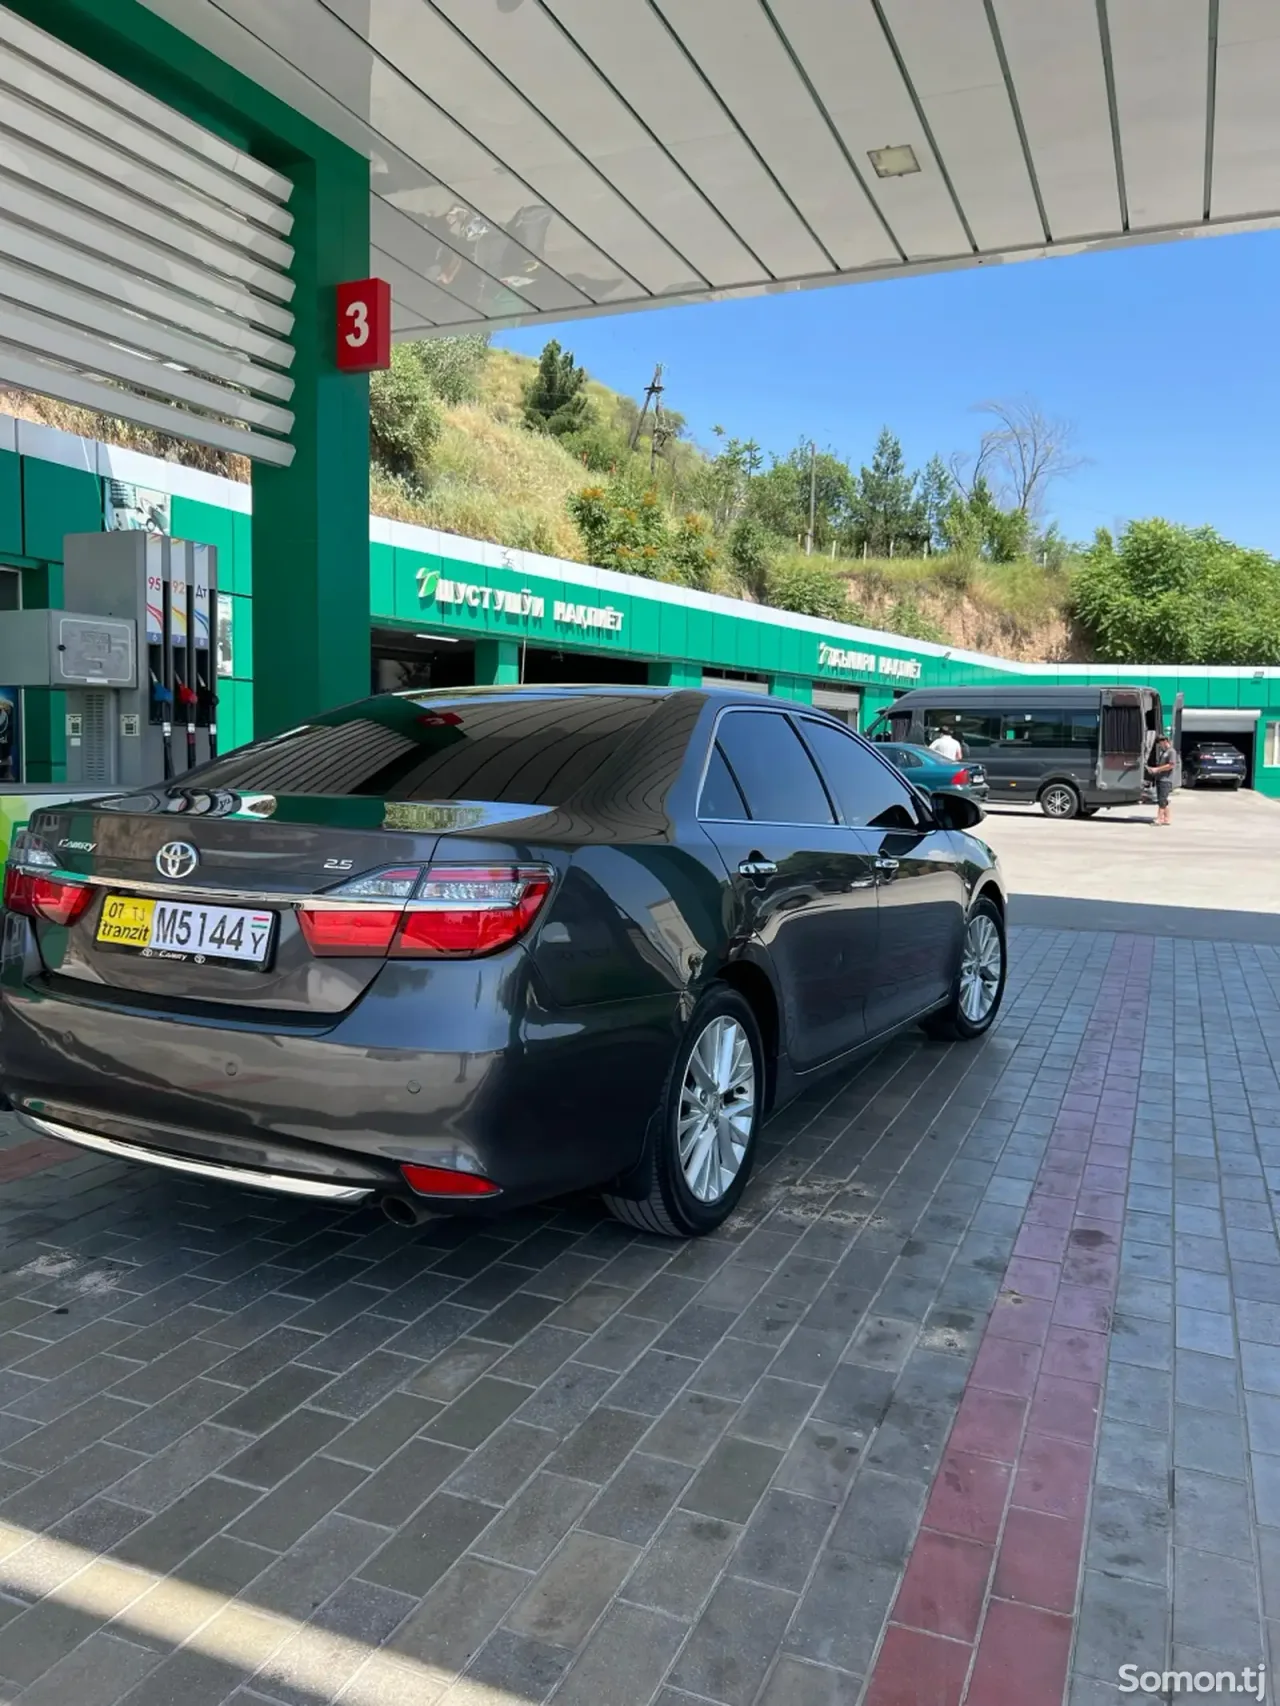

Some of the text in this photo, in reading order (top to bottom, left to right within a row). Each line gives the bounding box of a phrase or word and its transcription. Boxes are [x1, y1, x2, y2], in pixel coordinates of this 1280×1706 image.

[345, 300, 369, 348] 3
[148, 577, 161, 591] 95
[172, 580, 185, 595] 92
[108, 902, 146, 922] 07 TJ
[101, 920, 150, 942] tranzit
[156, 907, 245, 951] M5144
[251, 932, 266, 955] Y
